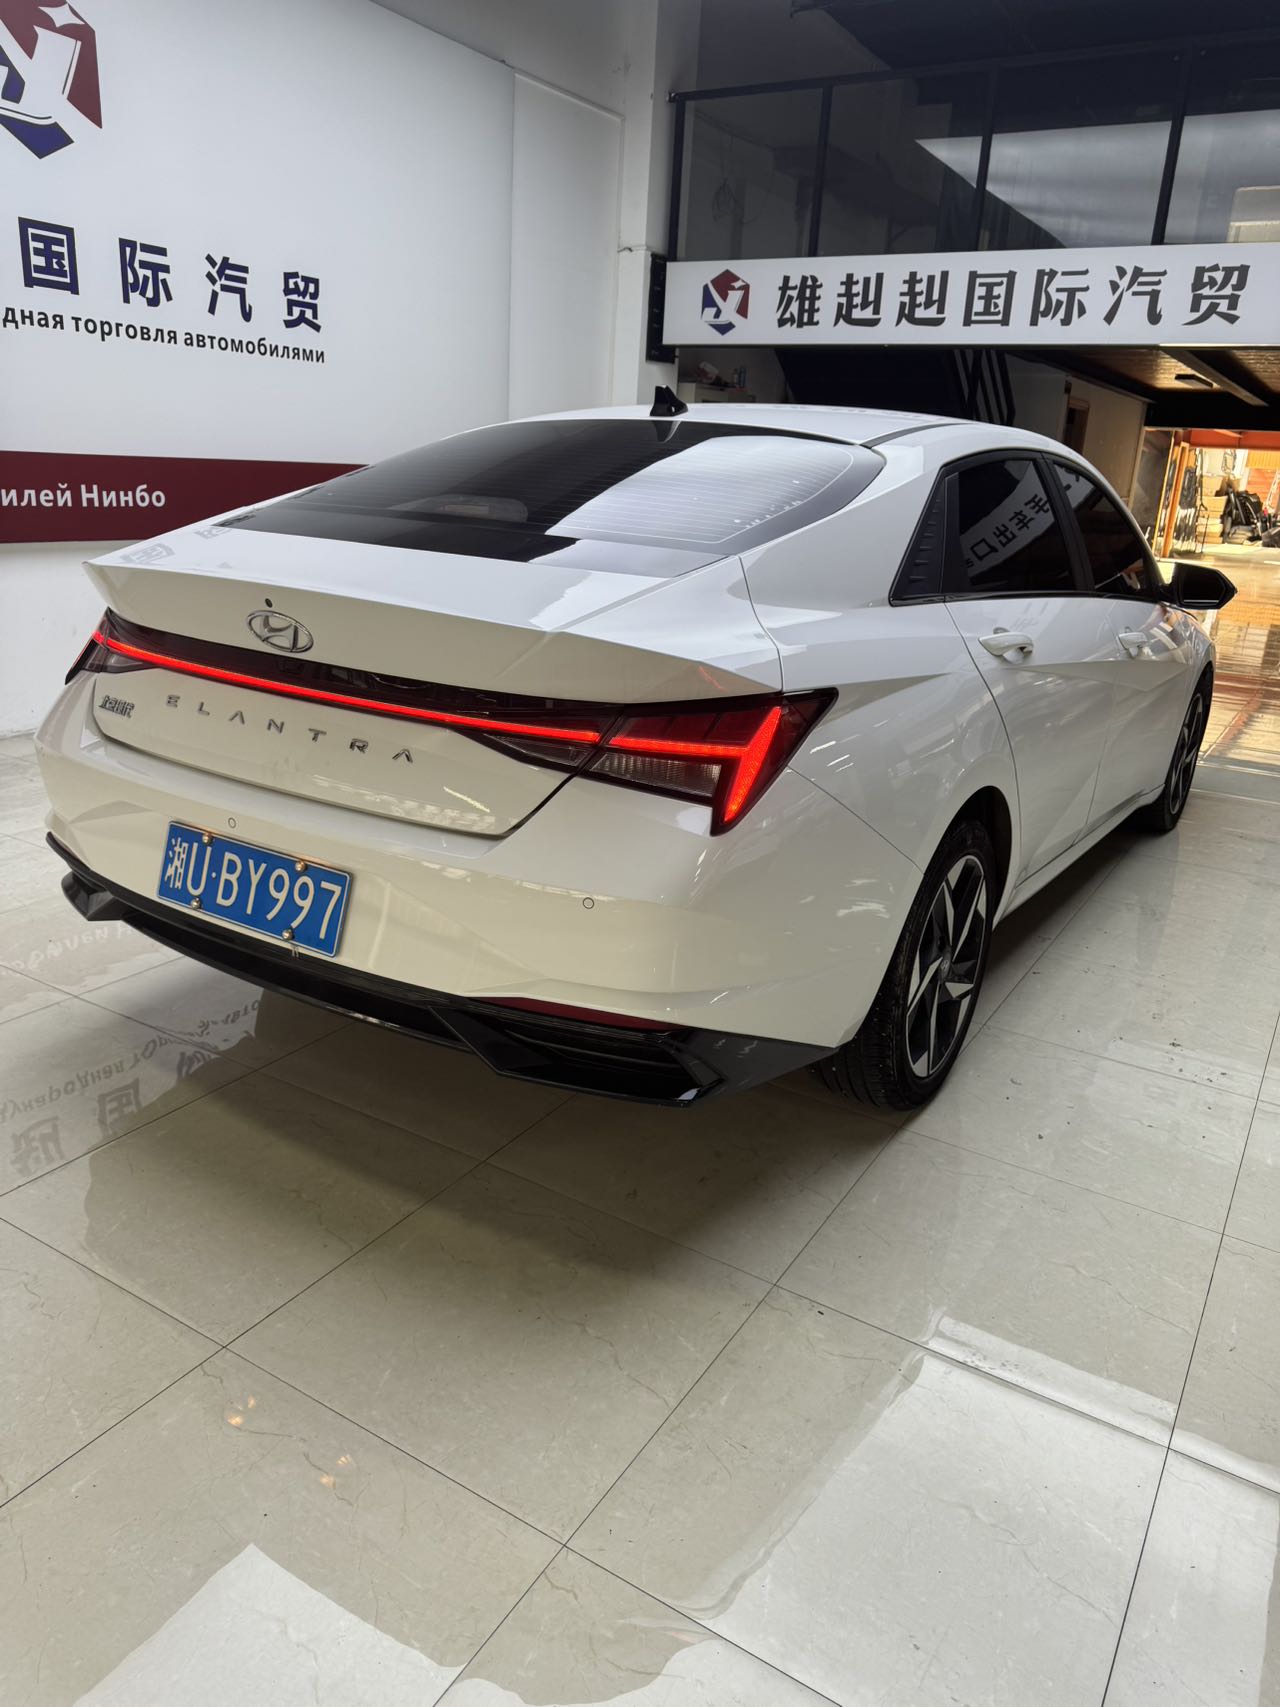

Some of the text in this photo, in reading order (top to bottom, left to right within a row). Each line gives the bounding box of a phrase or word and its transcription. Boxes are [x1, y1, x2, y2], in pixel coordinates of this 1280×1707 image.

[18, 216, 322, 333] 国际汽贸
[776, 263, 1251, 329] 雄赳赳国际汽贸
[2, 306, 325, 363] дная торговля автомобилями
[0, 482, 166, 508] илей Нинбо
[166, 694, 414, 764] ELANTRA
